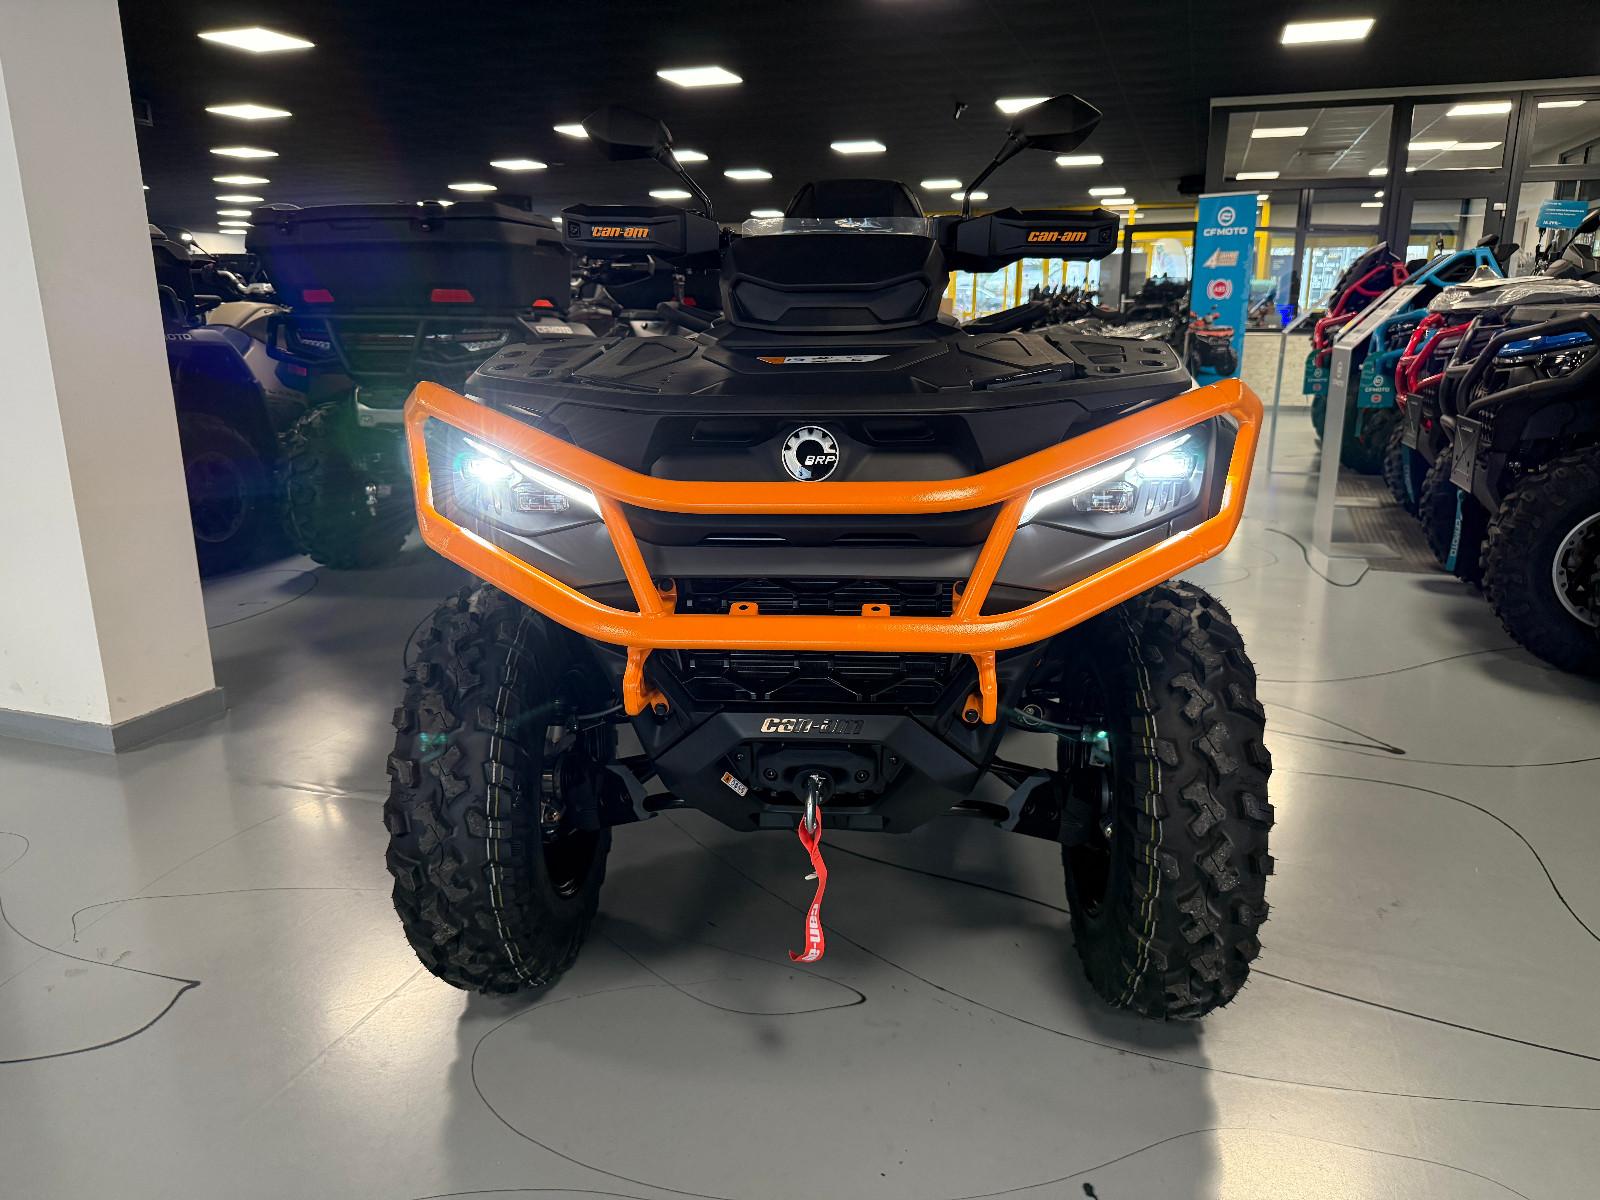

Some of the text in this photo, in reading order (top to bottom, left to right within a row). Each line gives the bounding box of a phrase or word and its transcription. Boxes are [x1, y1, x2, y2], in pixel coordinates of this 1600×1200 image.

[592, 226, 649, 238] can-am
[1028, 231, 1087, 242] can-am
[1203, 227, 1248, 236] CFMOTO
[804, 455, 836, 466] BRP
[760, 717, 865, 735] can-am
